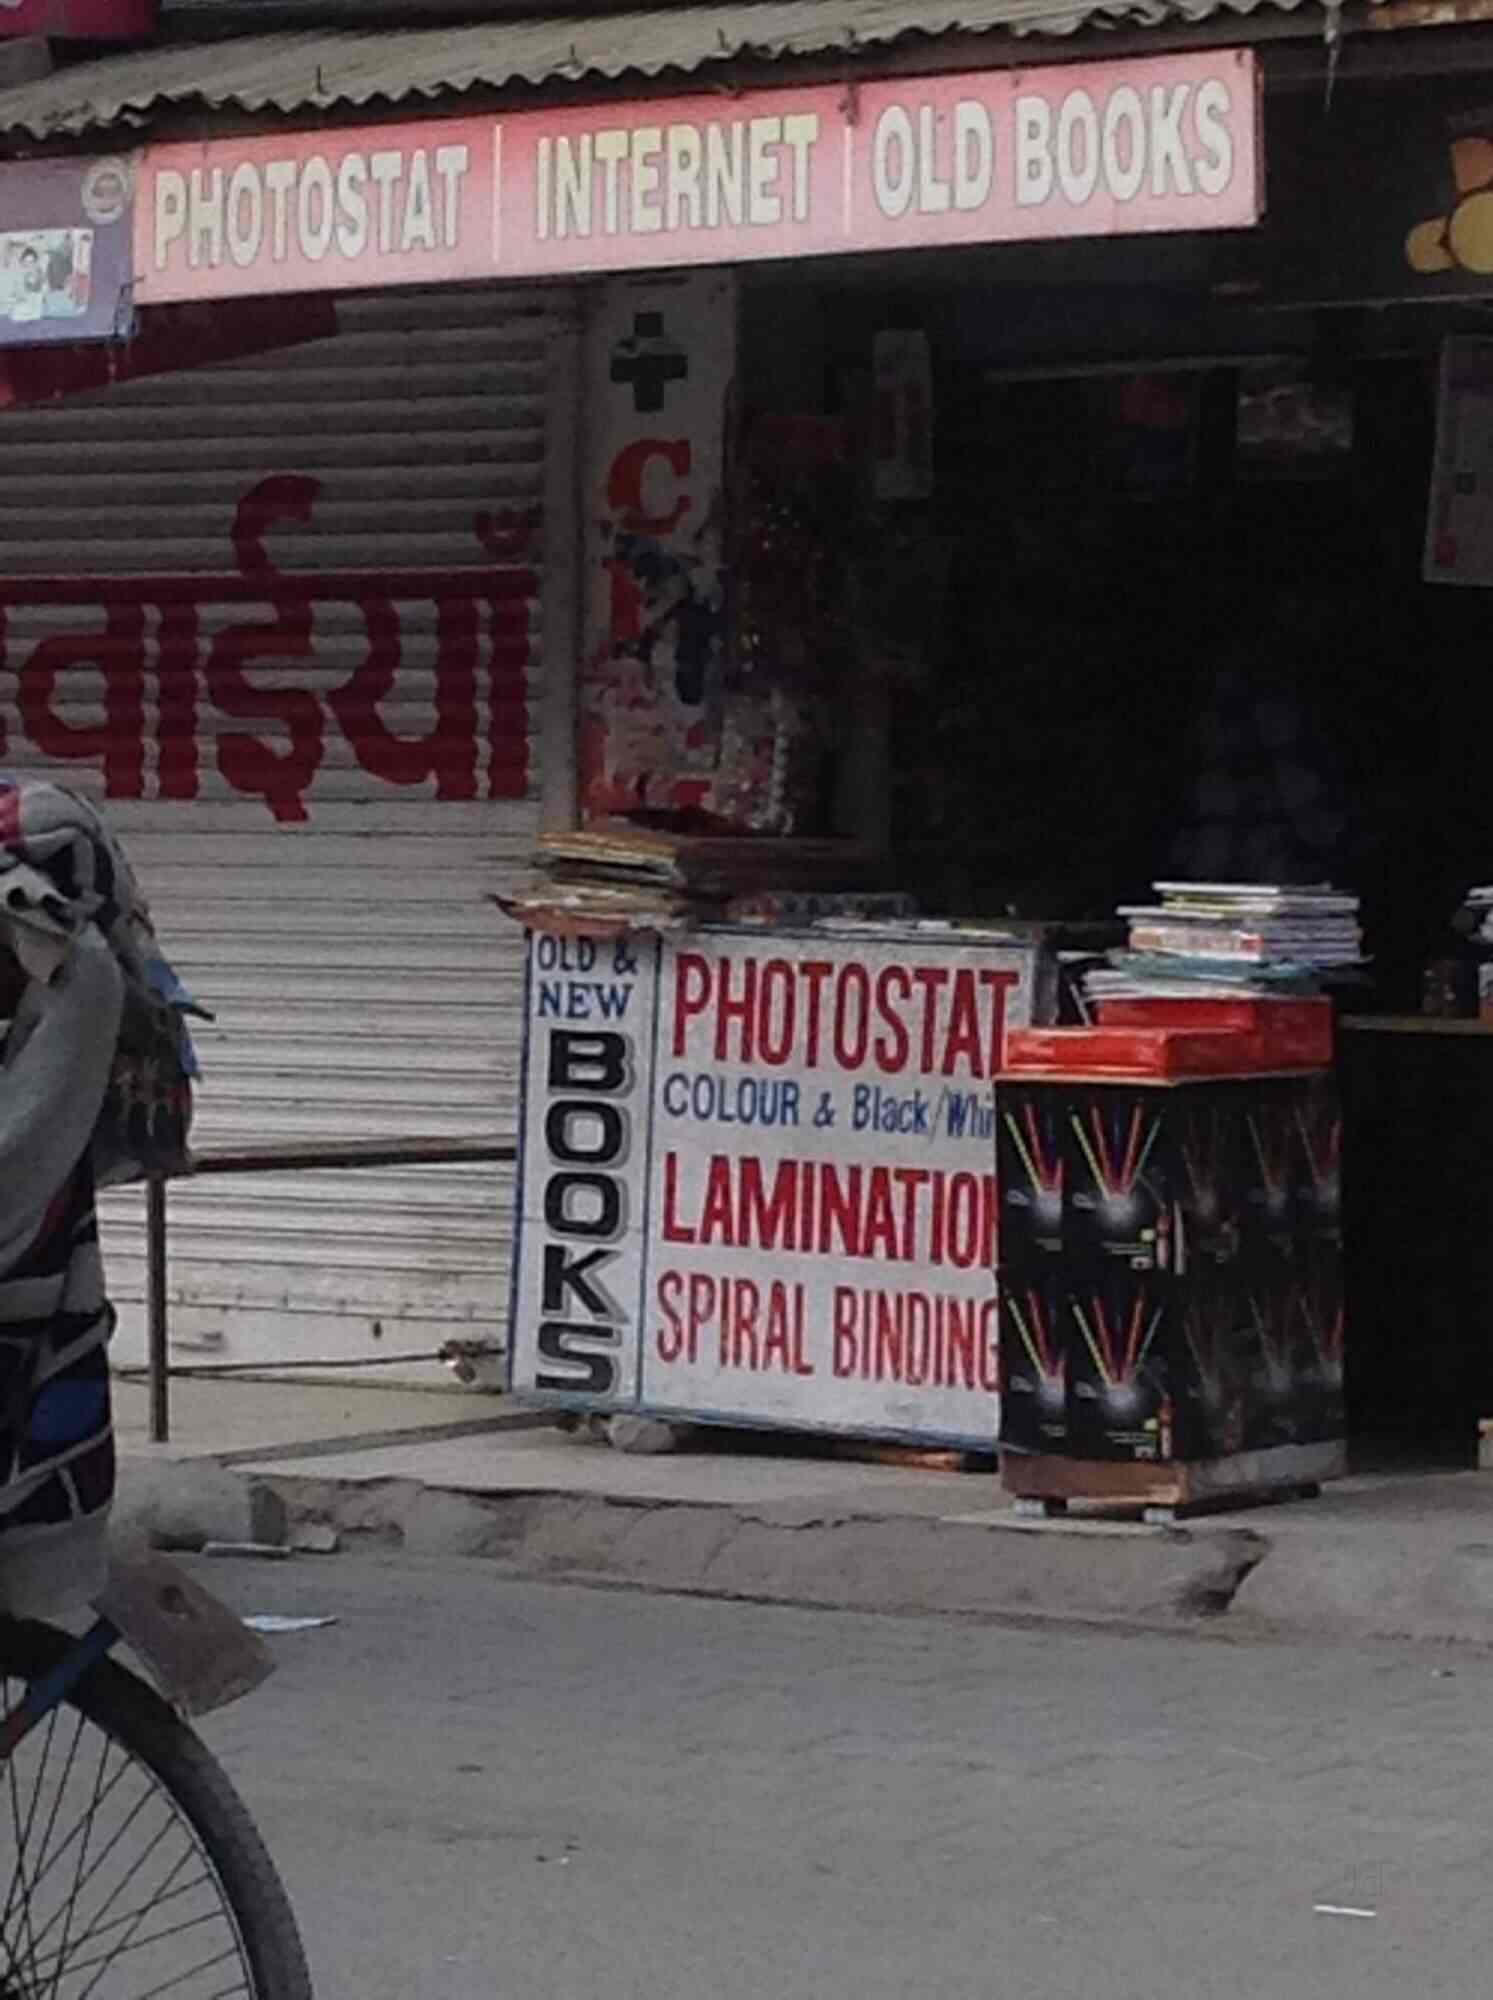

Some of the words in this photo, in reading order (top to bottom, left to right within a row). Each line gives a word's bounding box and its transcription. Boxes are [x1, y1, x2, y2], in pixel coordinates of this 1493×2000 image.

[154, 145, 469, 270] PHOTOSTAT
[536, 112, 819, 241] INTERNET
[872, 99, 994, 218] OLD
[1013, 78, 1233, 207] BOOKS
[0, 475, 537, 823] वाईयाँ
[538, 935, 596, 972] OLD
[613, 936, 638, 975] &
[538, 981, 634, 1019] NEW
[671, 953, 1019, 1080] PHOTOSTAT
[663, 1073, 800, 1127] COLOUR
[813, 1091, 836, 1128] &
[536, 1029, 635, 1394] BOOKS
[656, 1270, 814, 1376] SPIRAL
[832, 1286, 1000, 1392] BINDING
